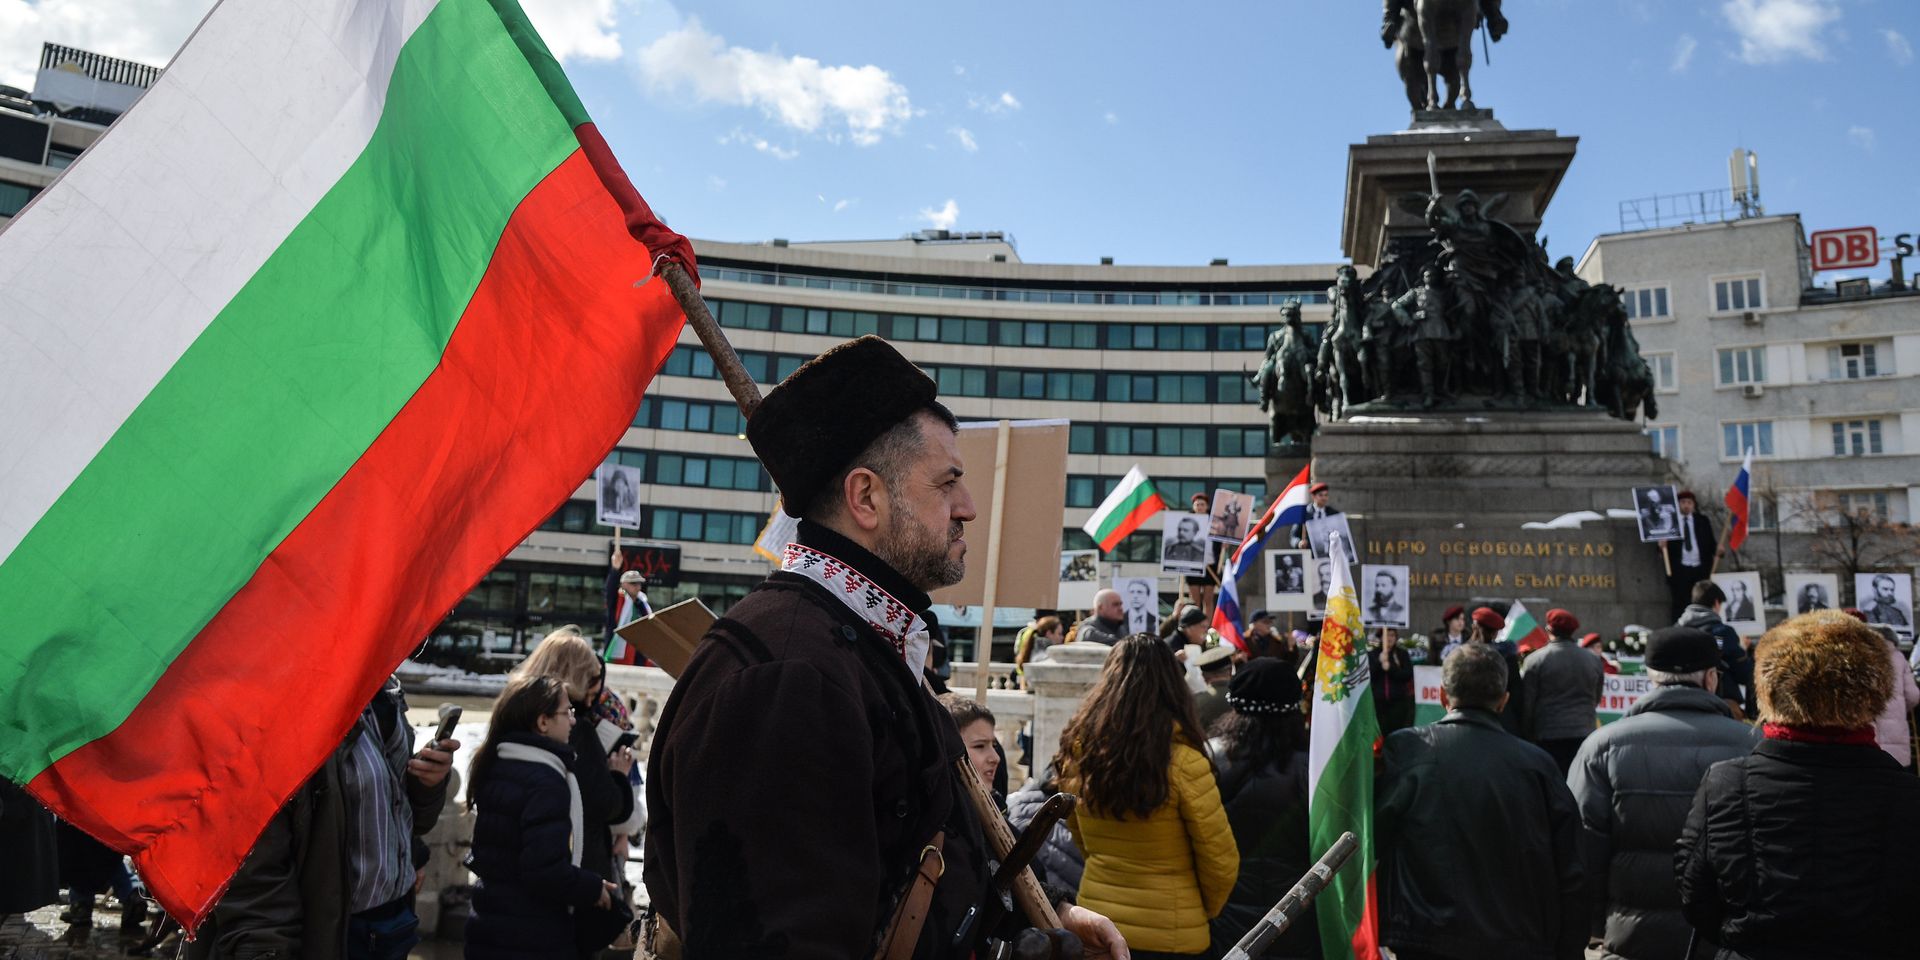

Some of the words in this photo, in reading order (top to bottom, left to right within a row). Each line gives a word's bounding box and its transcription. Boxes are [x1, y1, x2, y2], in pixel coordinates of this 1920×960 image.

[1819, 234, 1871, 264] DB
[1894, 233, 1920, 257] S
[1368, 540, 1427, 555] ЦАРЮ
[1439, 540, 1615, 557] ОСВОБОДИТЕЛЮ
[1514, 573, 1616, 589] БЪЛГАРИЯ
